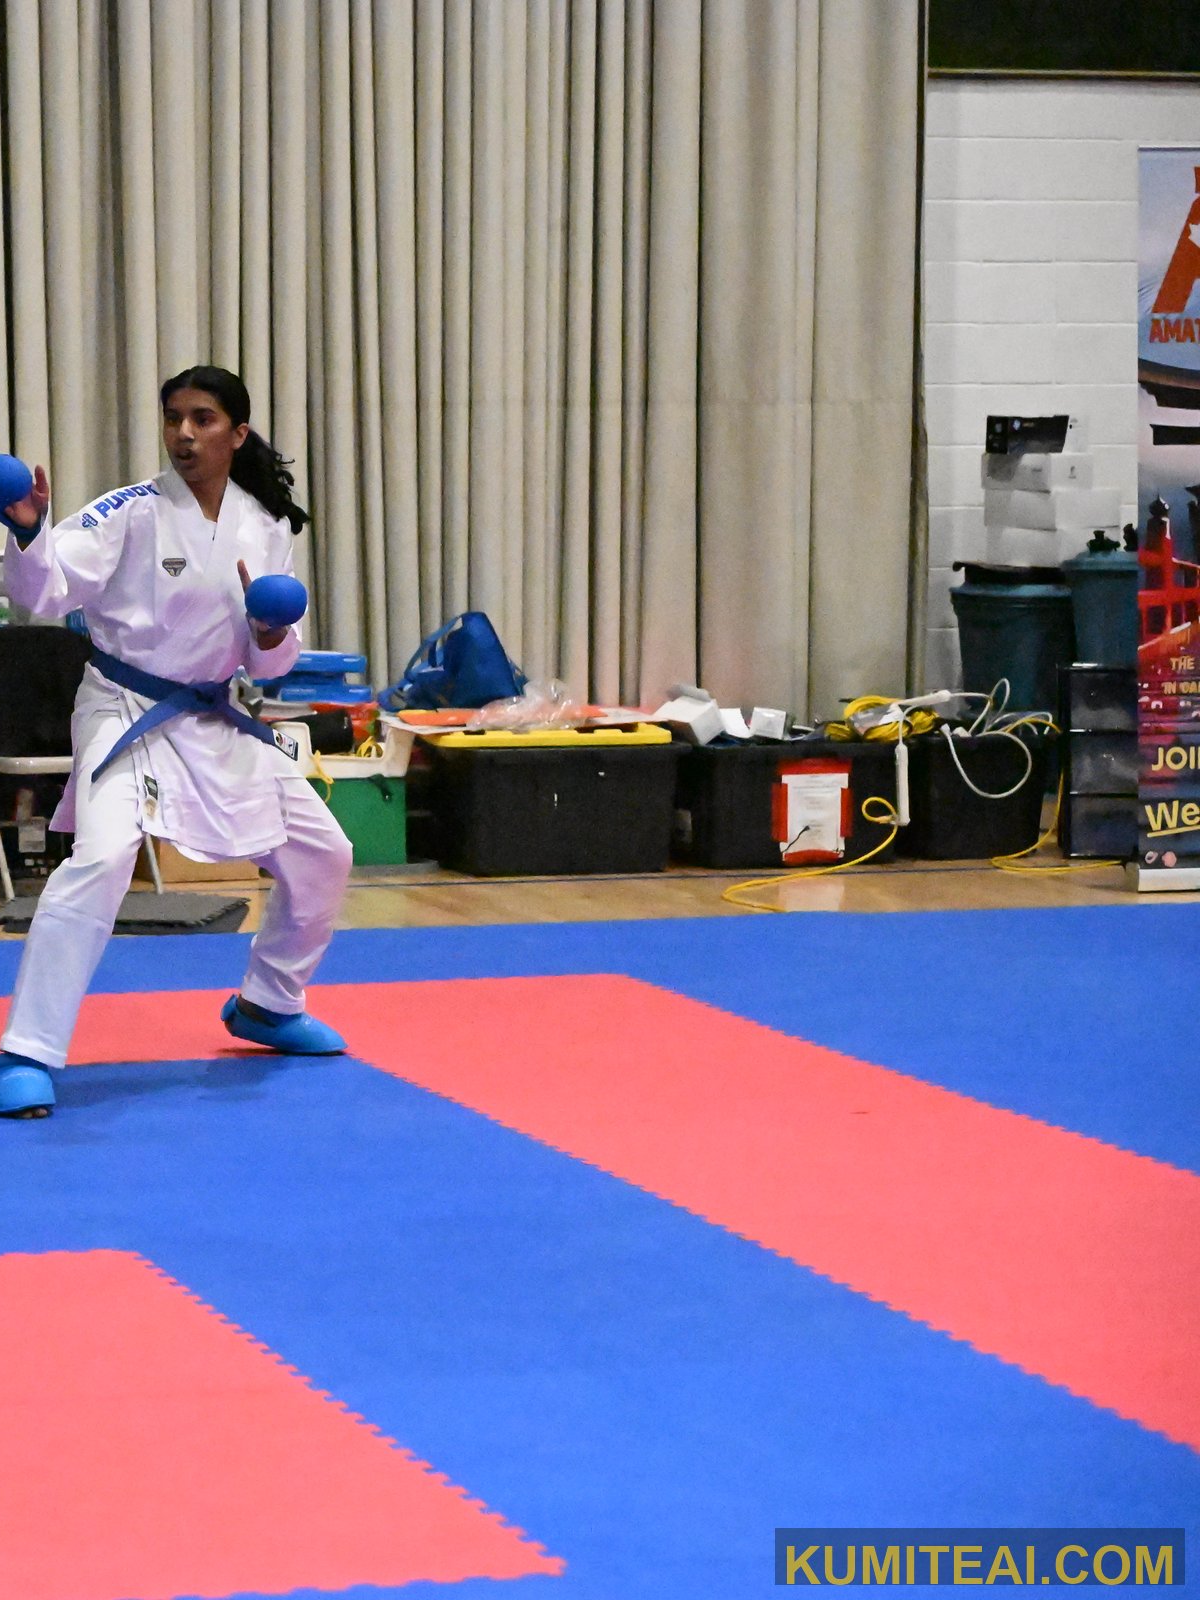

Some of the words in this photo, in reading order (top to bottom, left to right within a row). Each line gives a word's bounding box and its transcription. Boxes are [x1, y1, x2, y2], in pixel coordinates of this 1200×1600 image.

[1170, 656, 1195, 670] THE
[1179, 681, 1200, 694] CA
[1151, 746, 1200, 771] JOI
